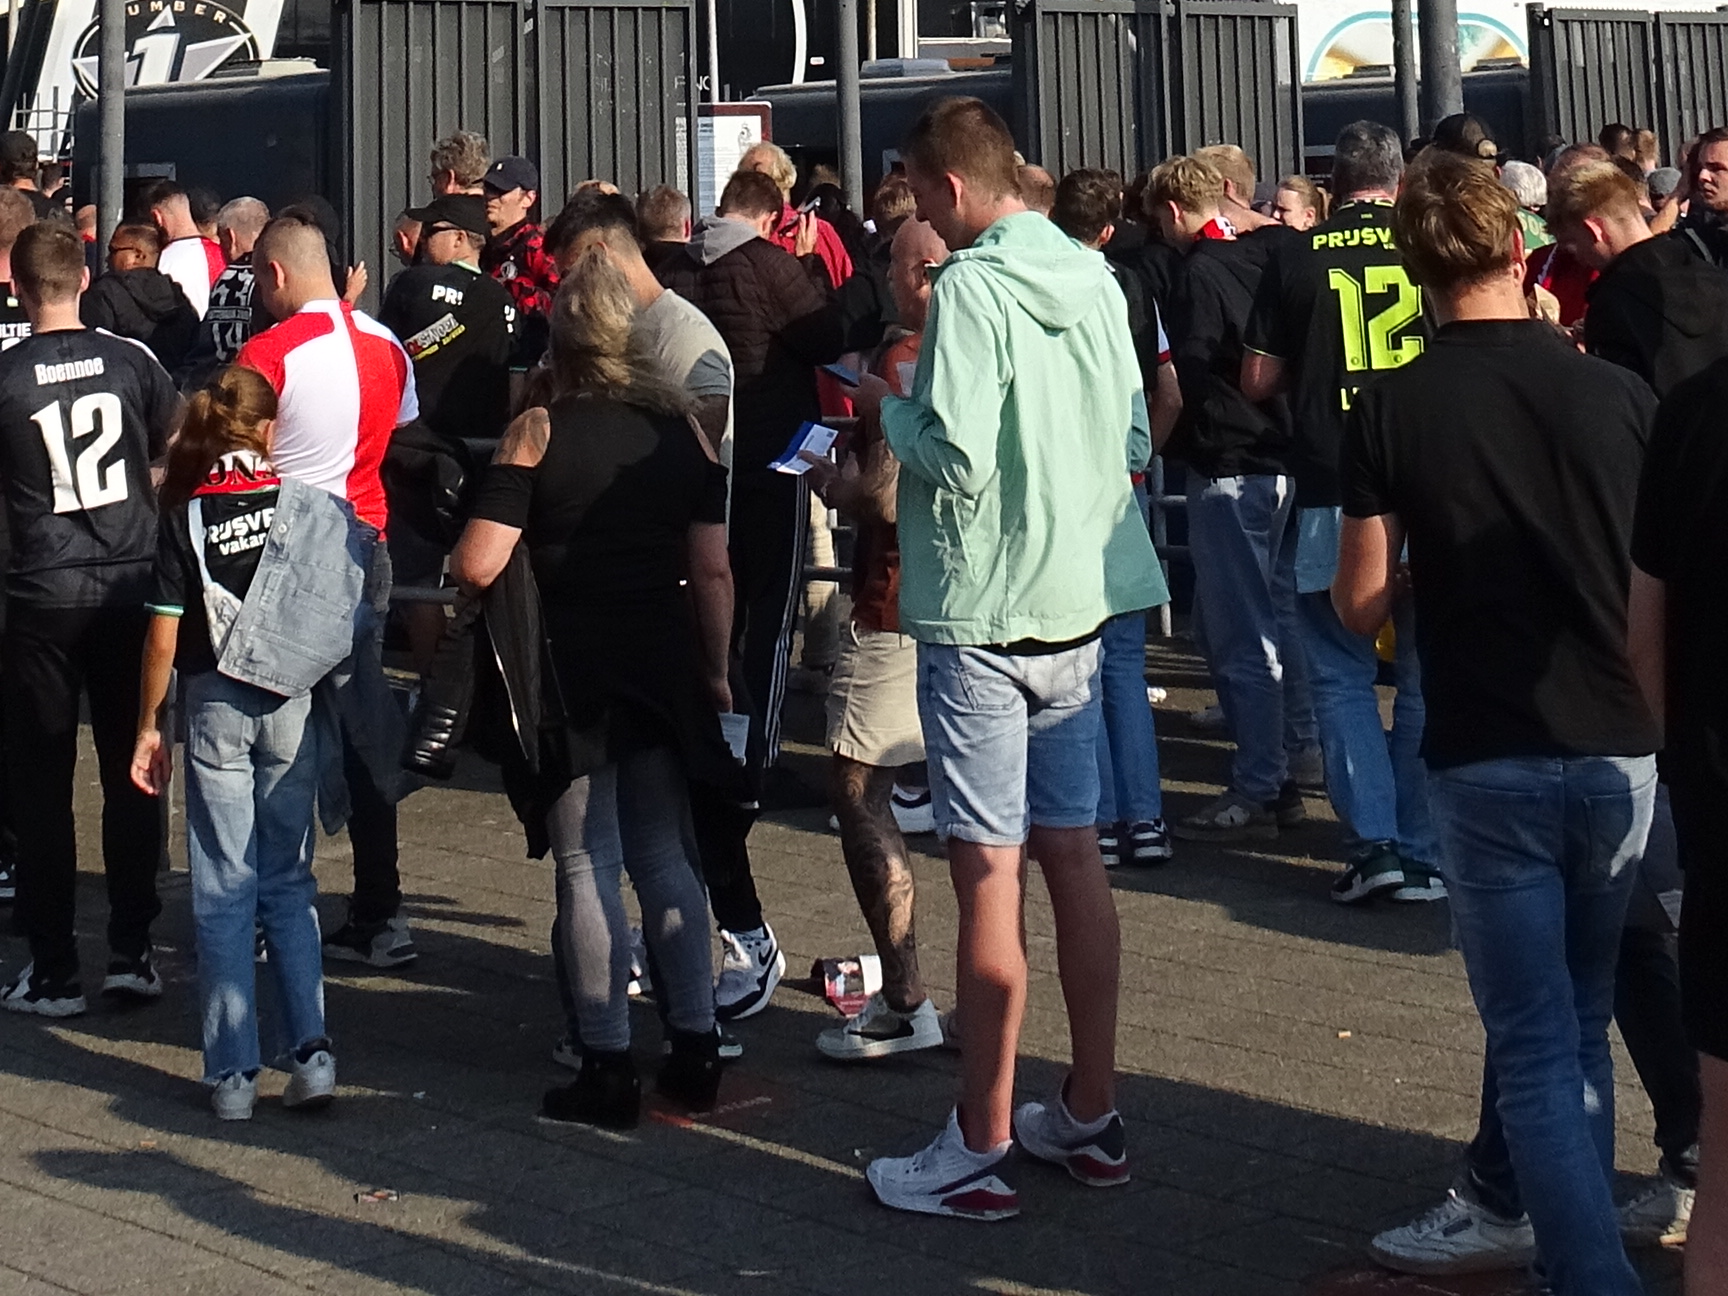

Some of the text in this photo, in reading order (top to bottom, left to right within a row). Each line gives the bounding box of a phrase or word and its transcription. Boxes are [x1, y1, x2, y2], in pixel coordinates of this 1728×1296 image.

[127, 0, 227, 24] UMBER
[132, 32, 180, 86] 1
[1328, 265, 1424, 372] 12
[34, 357, 104, 386] Boennoe
[29, 392, 129, 514] 12
